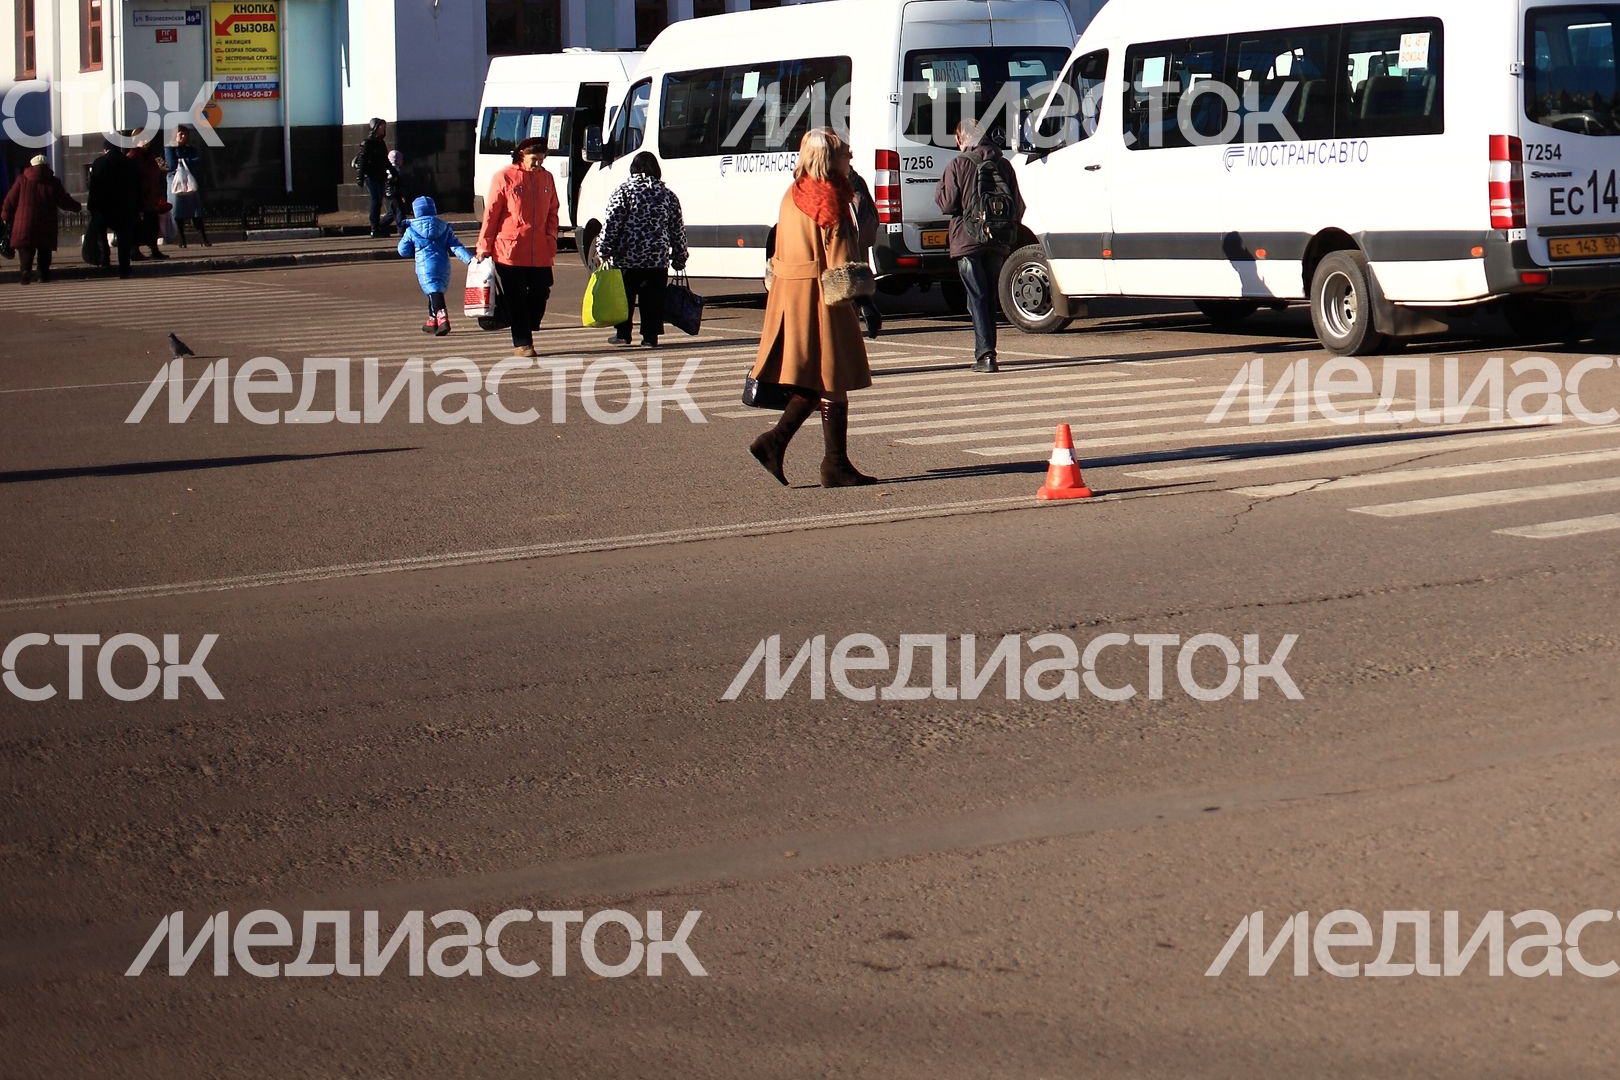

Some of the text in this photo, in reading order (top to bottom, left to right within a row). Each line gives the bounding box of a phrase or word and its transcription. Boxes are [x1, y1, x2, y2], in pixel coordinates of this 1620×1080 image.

[233, 4, 276, 14] КНОПКА
[234, 23, 276, 33] ВЫЗОВА
[1247, 139, 1370, 167] МОСТРАНСАВТО
[1526, 143, 1562, 161] 7254
[902, 155, 934, 170] 7256
[1576, 240, 1599, 253] 143
